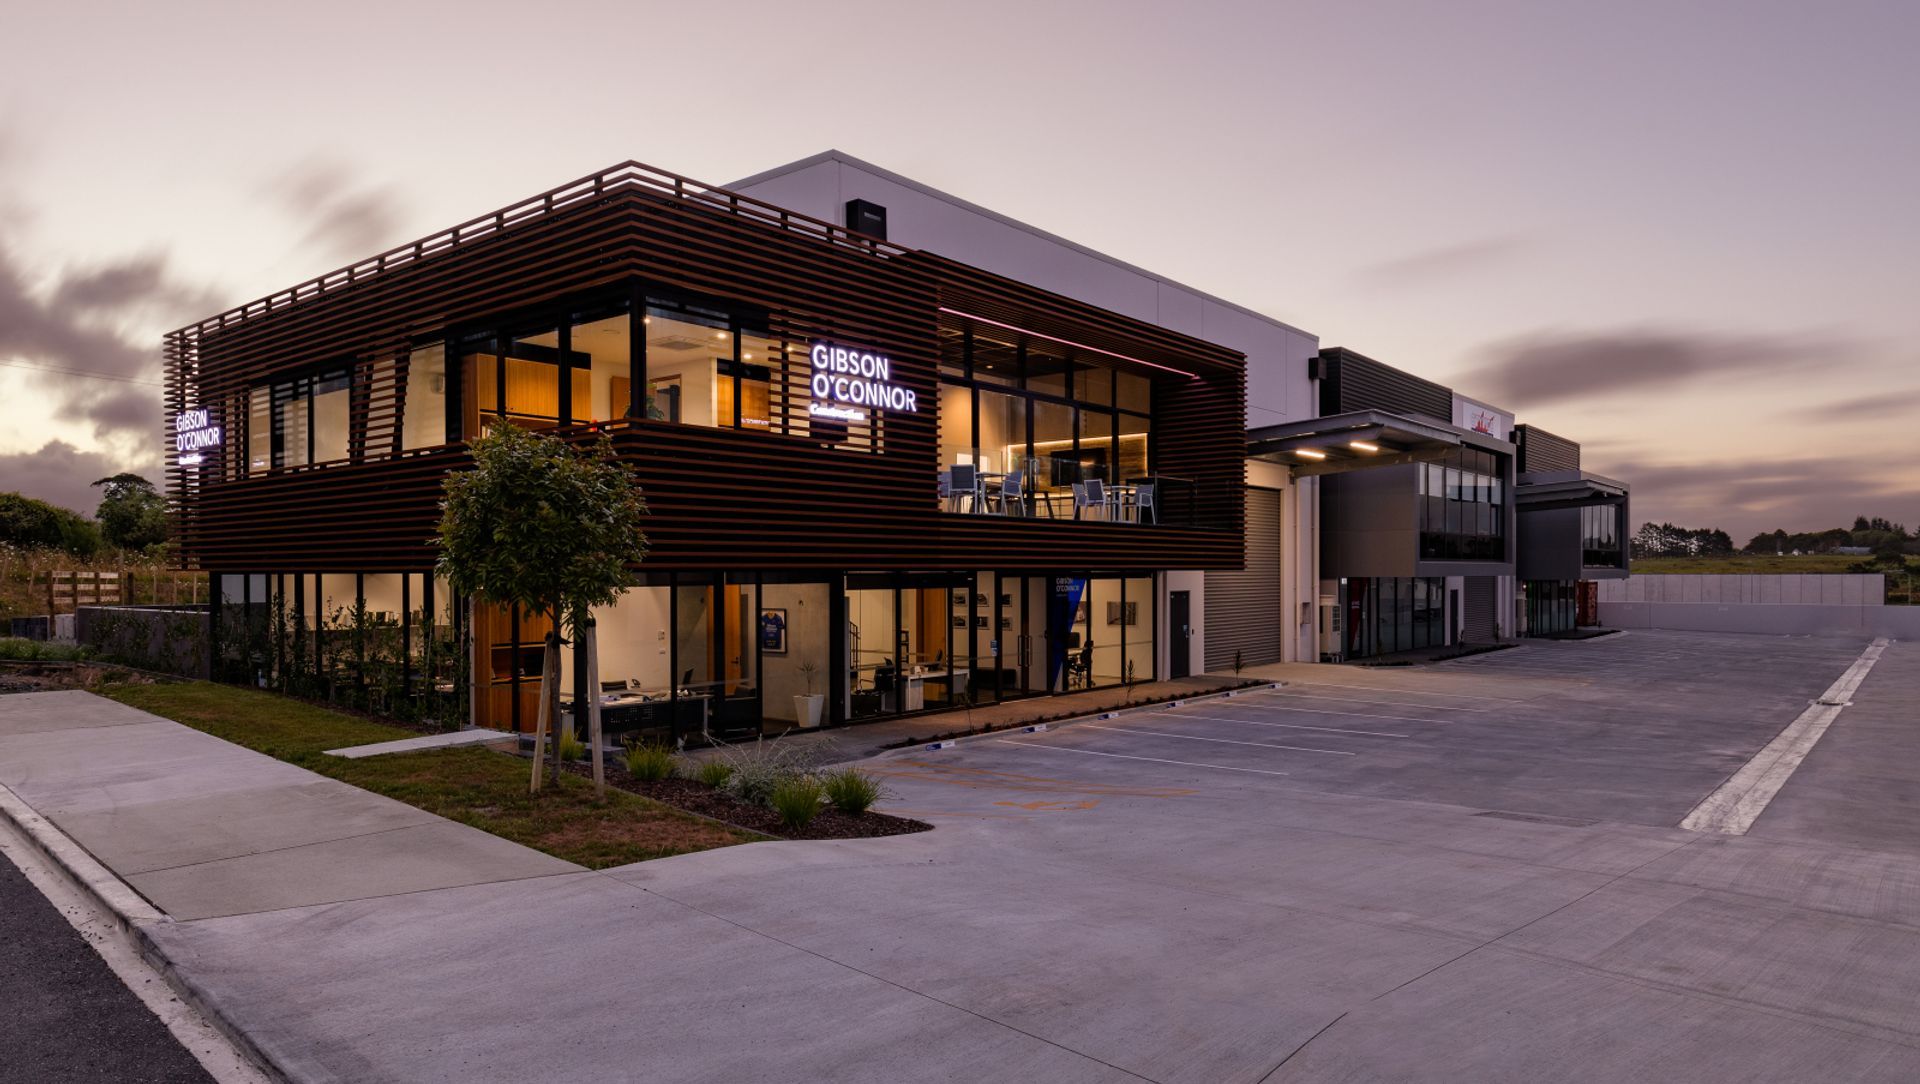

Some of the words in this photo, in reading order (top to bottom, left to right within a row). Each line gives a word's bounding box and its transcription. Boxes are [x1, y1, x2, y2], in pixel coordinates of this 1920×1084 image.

[812, 344, 888, 380] GIBSON
[812, 373, 917, 412] O'CONNOR
[176, 409, 207, 432] GIBSON
[176, 427, 220, 451] O'CONNOR
